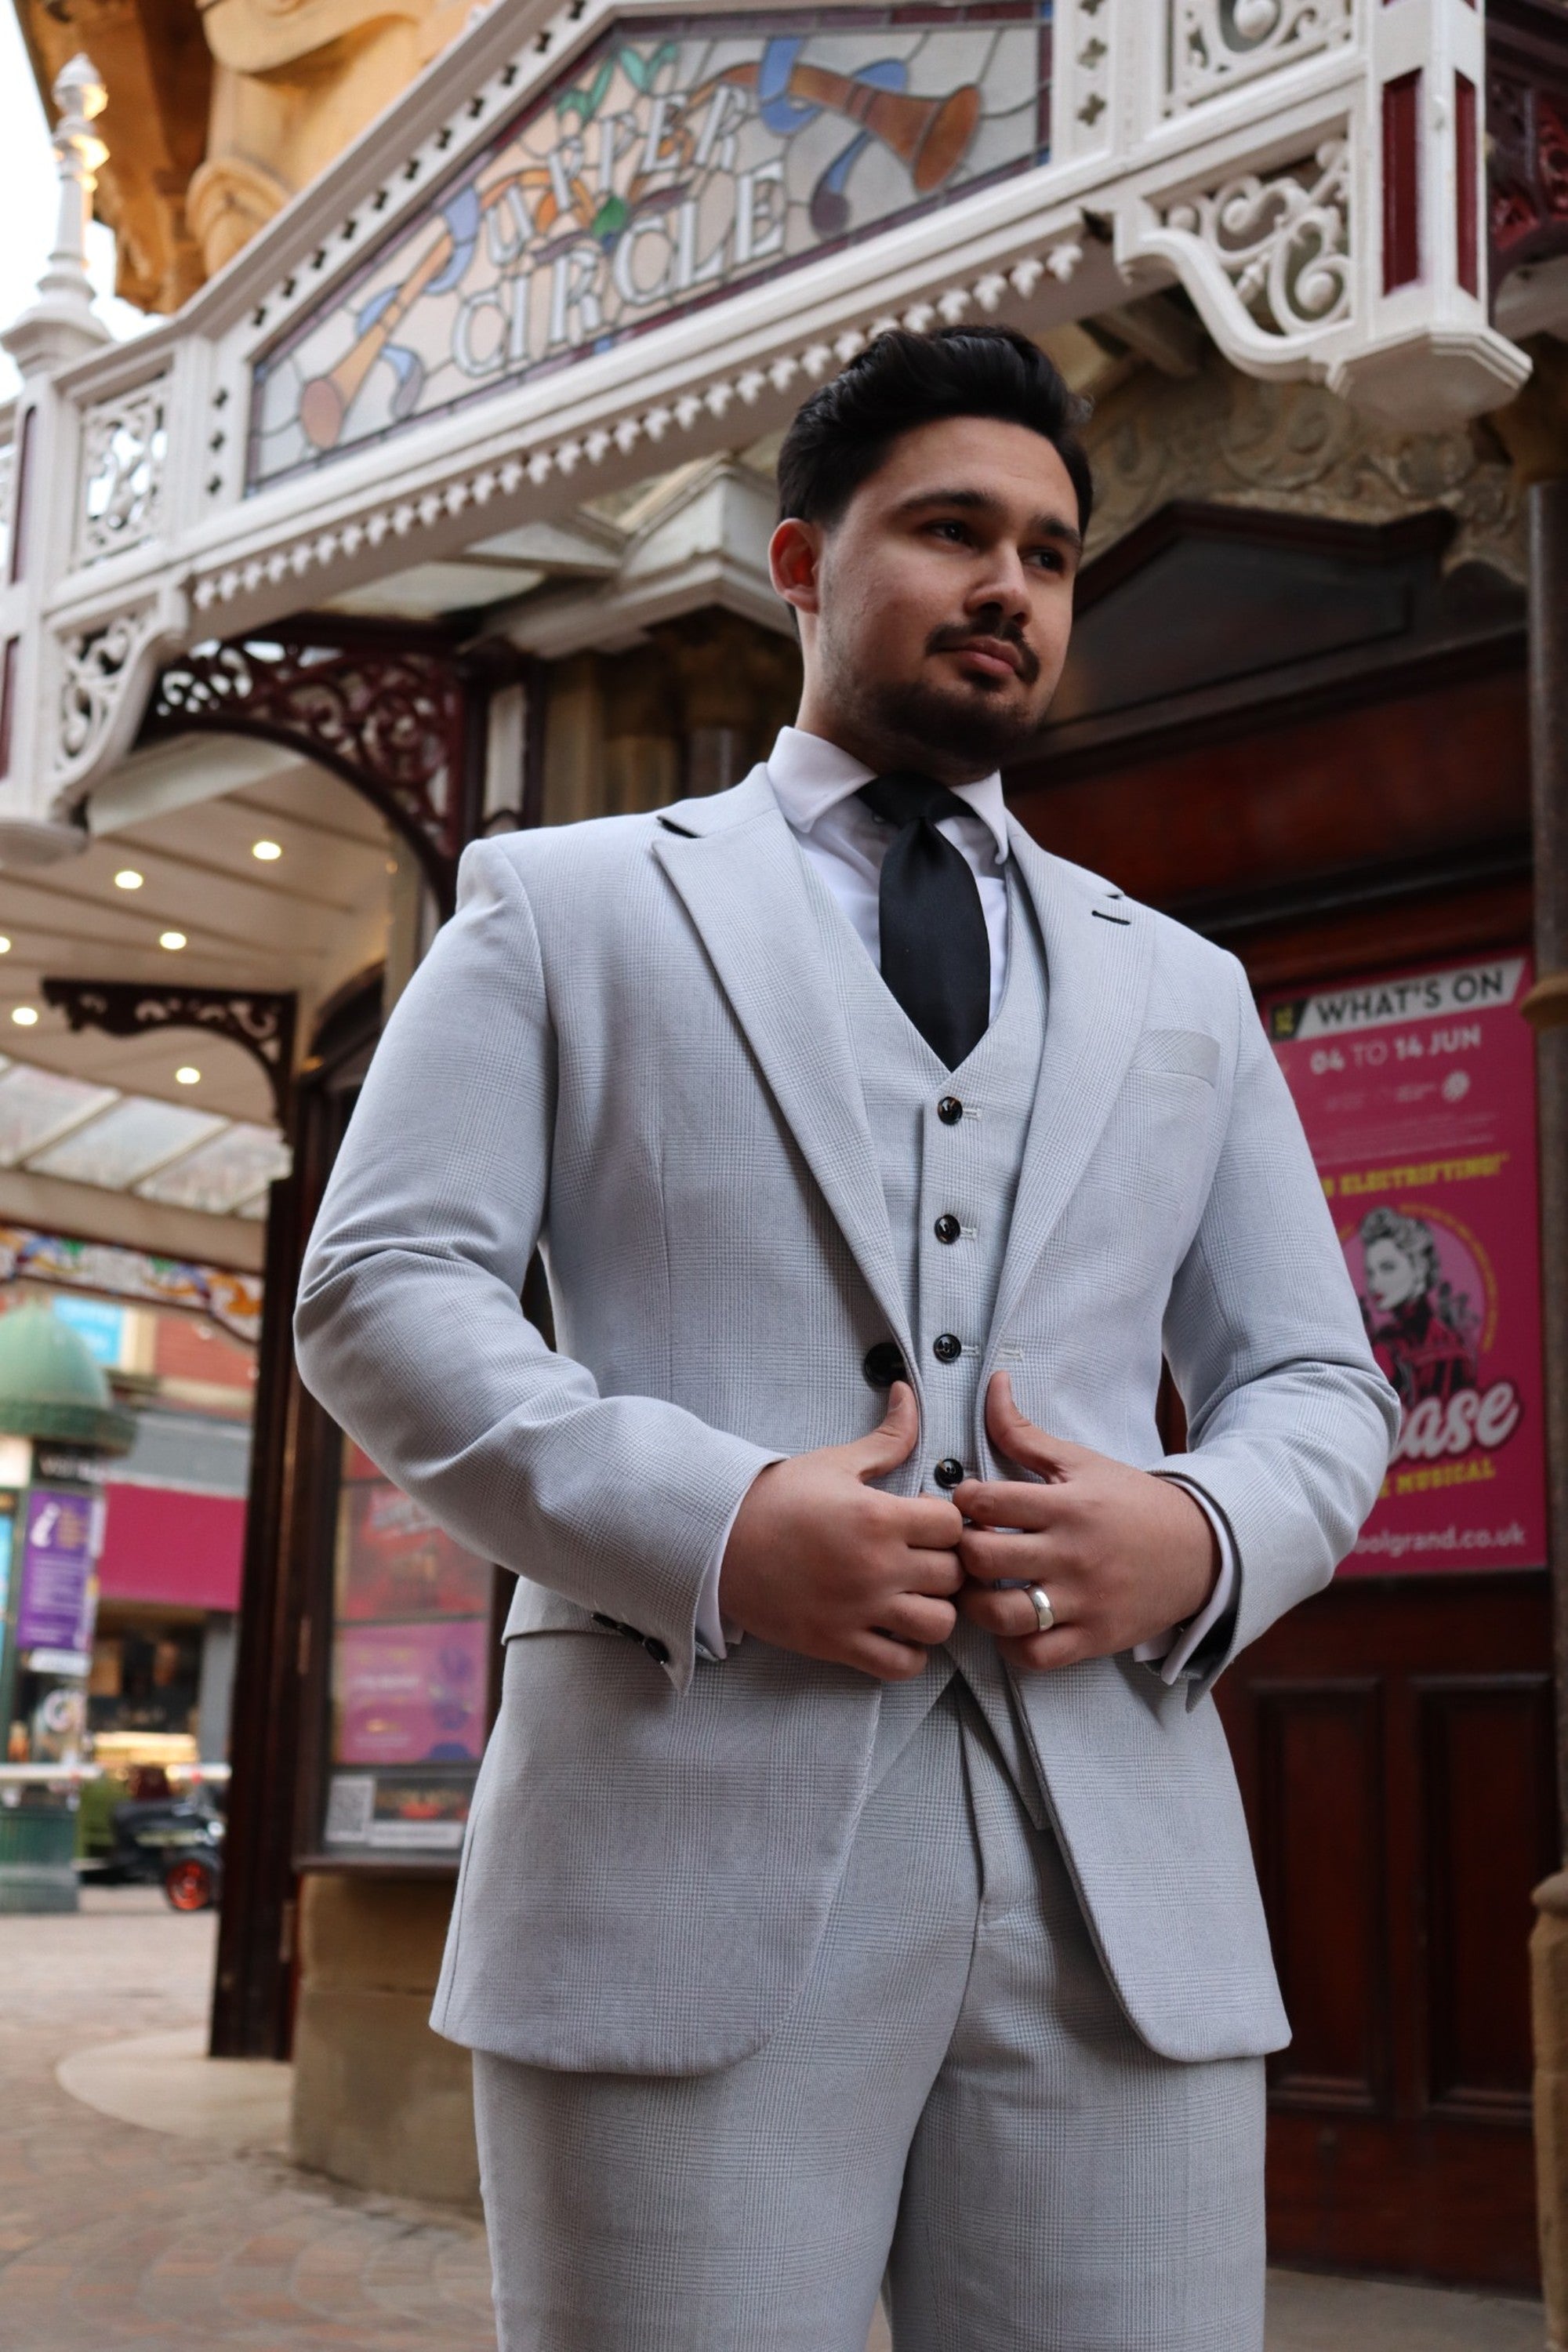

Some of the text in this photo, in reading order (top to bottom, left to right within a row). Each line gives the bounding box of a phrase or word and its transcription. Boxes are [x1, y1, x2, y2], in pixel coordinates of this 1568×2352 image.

[485, 83, 750, 267] UPPER
[451, 158, 784, 377] CIRCLE
[1316, 979, 1441, 1026] WHAT'S
[1453, 969, 1504, 1004] ON
[1350, 1039, 1388, 1069] TO
[1428, 1023, 1482, 1056] JUN
[1389, 1381, 1519, 1465] ase
[1396, 1458, 1495, 1494] MUSICAL
